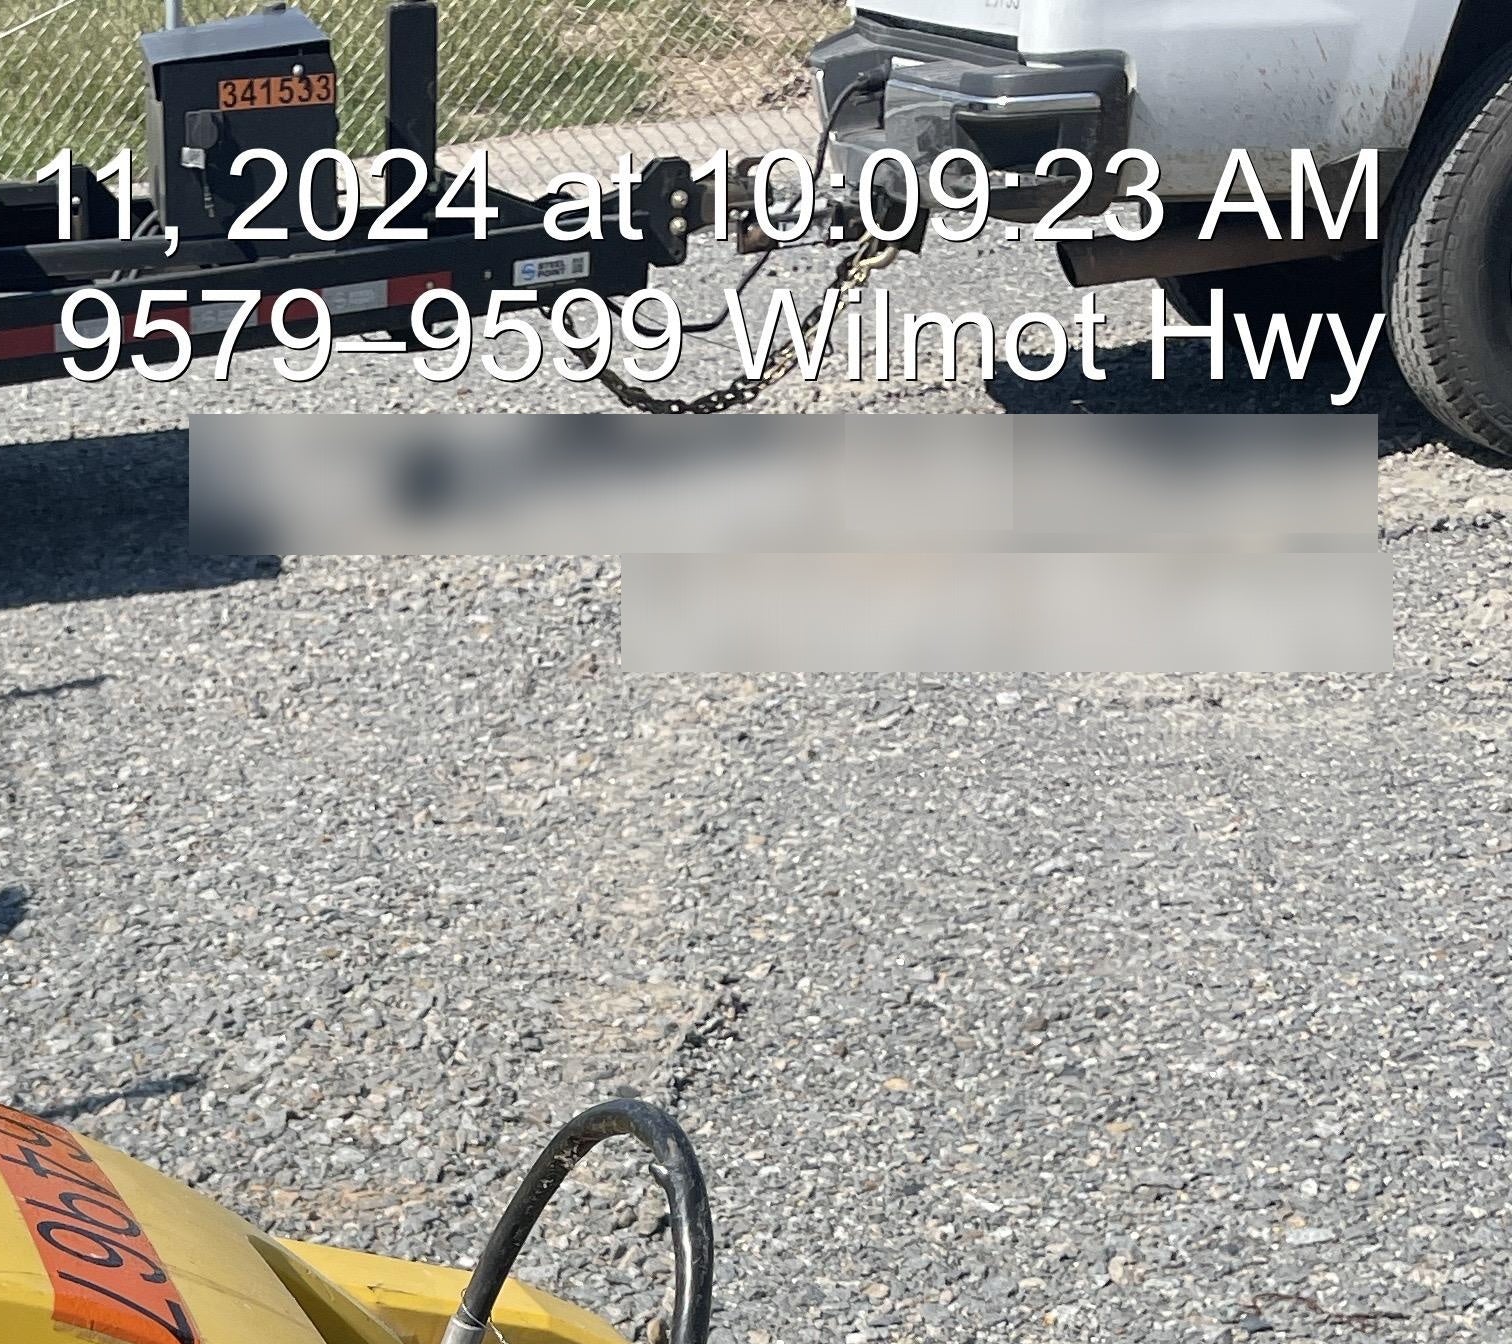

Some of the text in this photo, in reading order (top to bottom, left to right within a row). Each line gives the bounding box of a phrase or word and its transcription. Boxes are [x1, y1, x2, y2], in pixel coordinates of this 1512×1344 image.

[222, 74, 332, 109] 341533
[538, 260, 565, 269] STEEL
[538, 267, 565, 278] POINT
